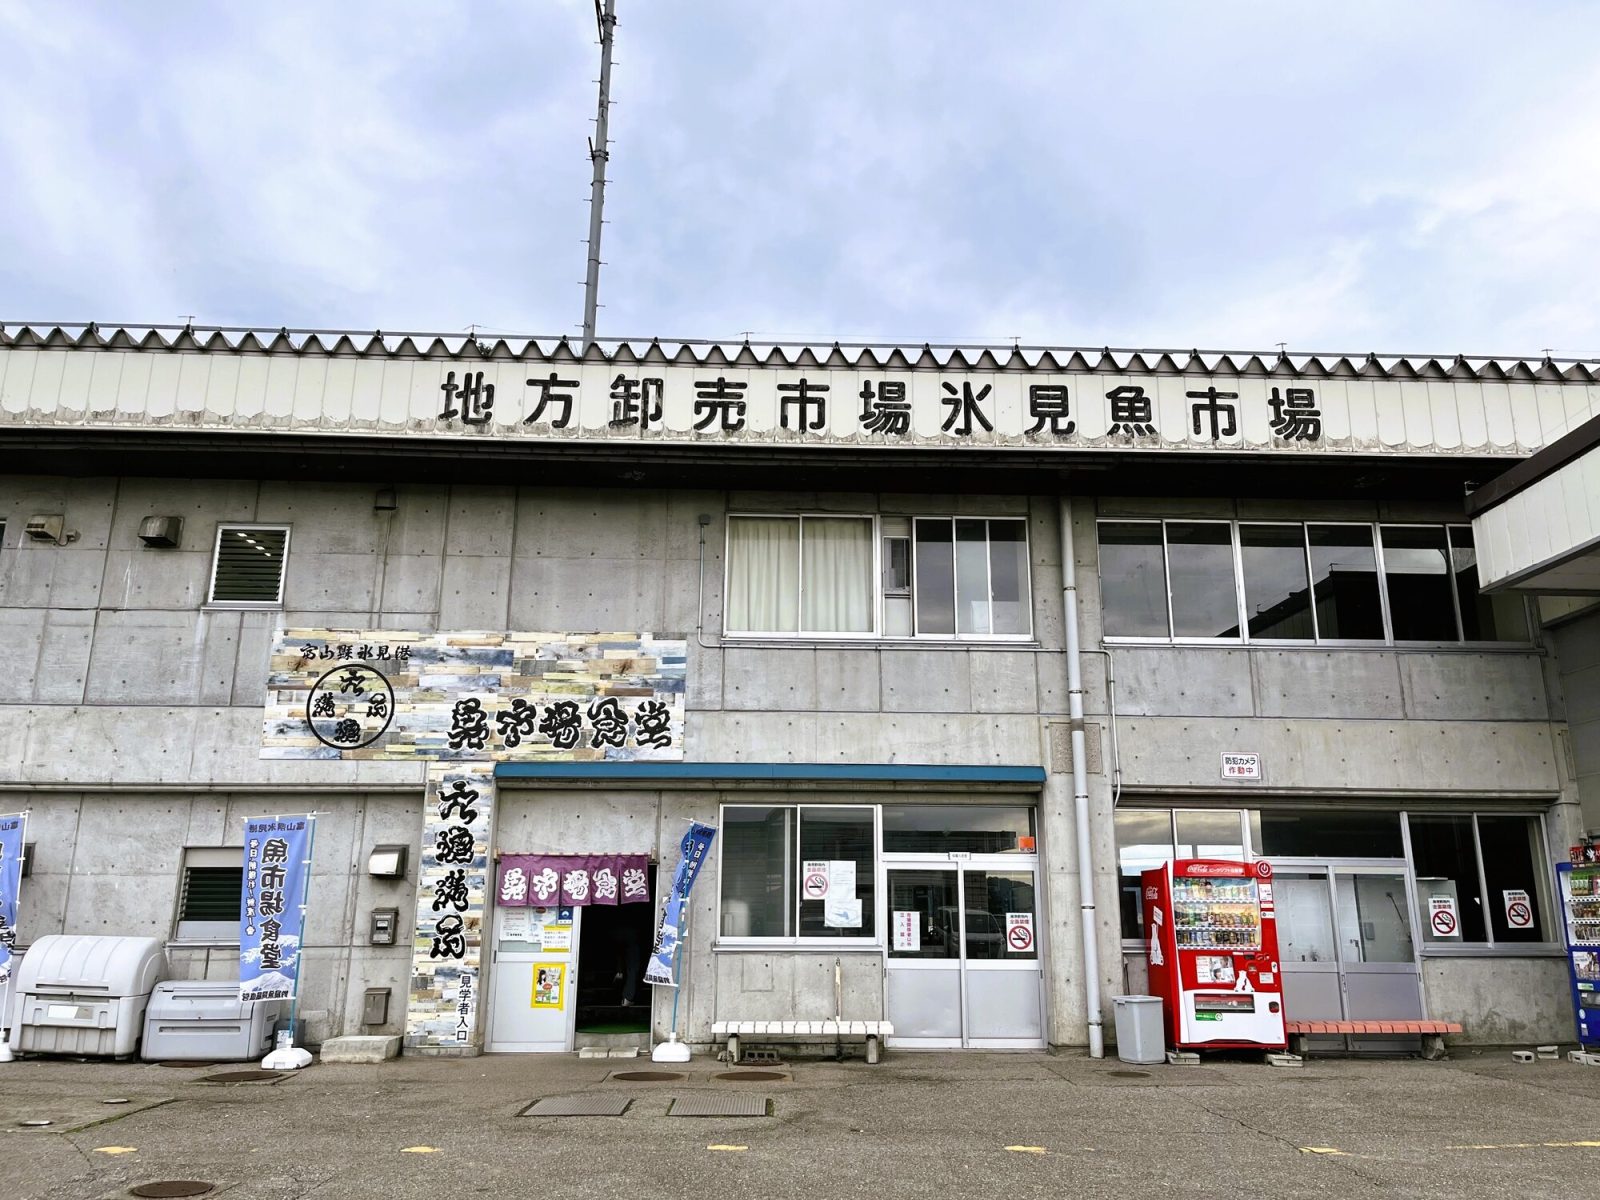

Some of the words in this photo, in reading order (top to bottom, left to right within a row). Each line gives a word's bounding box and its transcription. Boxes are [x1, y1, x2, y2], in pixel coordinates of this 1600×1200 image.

[441, 371, 1320, 441] 地方卸売市場氷見魚市場
[447, 697, 673, 751] 魚市場食堂
[1225, 757, 1256, 765] 防犯カメラ
[1228, 767, 1254, 775] 作動中
[501, 867, 647, 901] 魚市場食堂
[456, 975, 472, 1041] 見学者入口
